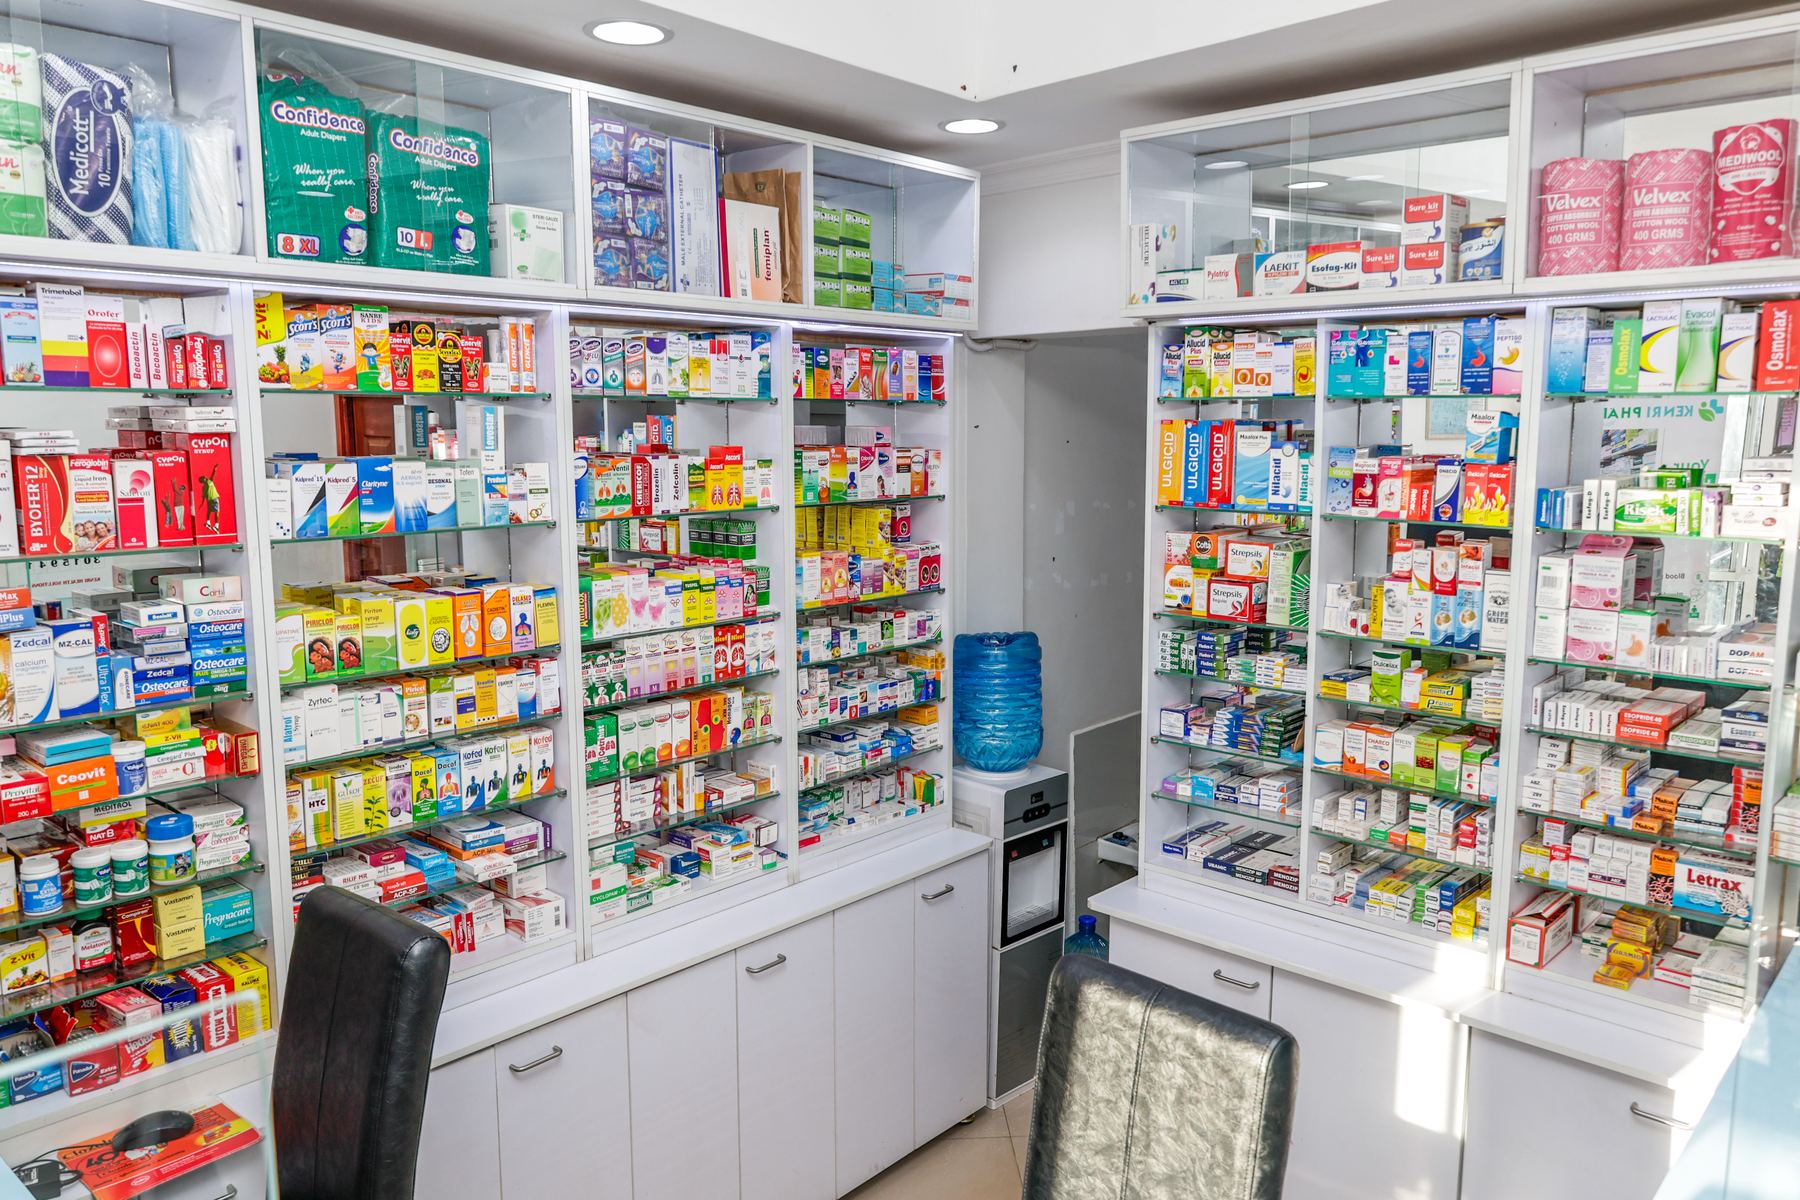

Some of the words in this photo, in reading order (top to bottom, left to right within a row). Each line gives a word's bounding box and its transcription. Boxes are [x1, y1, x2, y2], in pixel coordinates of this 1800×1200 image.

[273, 102, 365, 134] Confidence
[300, 128, 320, 139] Adult
[321, 131, 347, 142] Diapers
[70, 108, 91, 195] Medicott
[391, 130, 478, 165] Confidence
[415, 156, 433, 167] Adult
[1718, 150, 1782, 168] MEDIWOOL
[293, 163, 324, 175] When
[326, 168, 345, 181] you
[301, 176, 331, 192] really
[367, 153, 379, 214] Confidence
[410, 179, 436, 191] When
[438, 185, 454, 196] you
[1546, 193, 1601, 212] Velvex
[1632, 187, 1692, 206] Velvex
[1408, 204, 1425, 212] Sure
[1427, 203, 1439, 211] kit
[1633, 208, 1651, 217] SUPER
[1653, 206, 1690, 217] ABSORBENT
[1547, 222, 1575, 232] COTTON
[1577, 220, 1599, 230] WOOL
[1633, 219, 1662, 229] COTTON
[1666, 217, 1689, 226] WOOL
[400, 230, 413, 243] 10
[1547, 234, 1562, 244] 400
[1565, 231, 1596, 243] GRMS
[1633, 231, 1649, 241] 400
[1651, 228, 1684, 239] GRMS
[282, 236, 294, 253] 8
[299, 237, 318, 254] XL
[764, 230, 773, 281] femiplan
[1384, 253, 1395, 262] kit
[1408, 251, 1426, 259] Sure
[1428, 250, 1439, 258] kit
[1264, 262, 1299, 272] LAEKIT
[1311, 262, 1357, 274] Esofag-Kit
[41, 287, 82, 297] Trimetabol
[88, 308, 120, 318] Orofer
[1646, 313, 1678, 322] LACTULAC
[1686, 310, 1715, 319] Evacol
[257, 303, 269, 340] Z-Vit
[288, 321, 319, 335] SCOTT'S
[320, 316, 351, 333] SCOTT'S
[389, 337, 411, 345] Enervit
[1187, 339, 1206, 348] Allucid
[1766, 309, 1788, 371] Osmolax
[133, 331, 141, 380] Becoactin
[153, 333, 162, 381] Becoactin
[174, 345, 182, 364] Cypro
[214, 345, 222, 364] Cypro
[1213, 352, 1231, 360] Allucid
[1615, 328, 1631, 376] Osmolax
[1471, 413, 1495, 421] Maalox
[487, 407, 496, 450] Lovostar
[191, 437, 228, 448] CYPON
[70, 459, 108, 468] Feroglobin
[156, 455, 185, 464] CYPON
[1162, 432, 1174, 487] ULGICID
[1188, 433, 1200, 489] ULGICID
[1212, 433, 1224, 490] ULGICID
[1272, 458, 1281, 495] Nilacid
[1300, 464, 1309, 501] Nilacid
[1624, 502, 1664, 516] Risek
[1231, 548, 1263, 558] Strepsils
[1212, 588, 1243, 598] Strepsils
[207, 607, 243, 616] Osteocare
[200, 622, 243, 634] Osteocare
[306, 618, 333, 626] PIRICLOR
[14, 636, 51, 648] Zedcal
[58, 638, 92, 648] MZ-CAL
[1729, 649, 1765, 658] DOPAM
[15, 659, 46, 667] calcium
[194, 656, 245, 670] Osteocare
[1373, 660, 1399, 669] Dulcolax
[98, 664, 108, 686] Ultra
[147, 668, 174, 678] Zedcal
[142, 679, 188, 693] Osteocare
[101, 686, 110, 706] Flex
[308, 696, 333, 707] Zyrtec
[284, 716, 292, 742] Alatrol
[533, 735, 552, 746] Kofed
[463, 747, 483, 760] Kofed
[484, 744, 505, 754] Kofed
[57, 767, 106, 785] Ceovit
[4, 786, 40, 798] Provital
[94, 800, 131, 813] MEDITROL
[308, 799, 326, 809] HTC
[89, 833, 105, 841] NAT
[107, 829, 115, 838] B
[1273, 872, 1299, 882] MENOZIP
[1687, 868, 1742, 892] Letrax
[1273, 880, 1299, 891] MENOZIP
[393, 887, 418, 899] ACP-SP
[164, 894, 194, 906] Vastamin
[204, 907, 251, 928] Pregnacare
[166, 926, 196, 938] Vastamin
[81, 938, 111, 952] Melatonin
[10, 953, 36, 965] Z-Vit
[72, 1063, 93, 1076] Panadol
[100, 1064, 117, 1074] Extra
